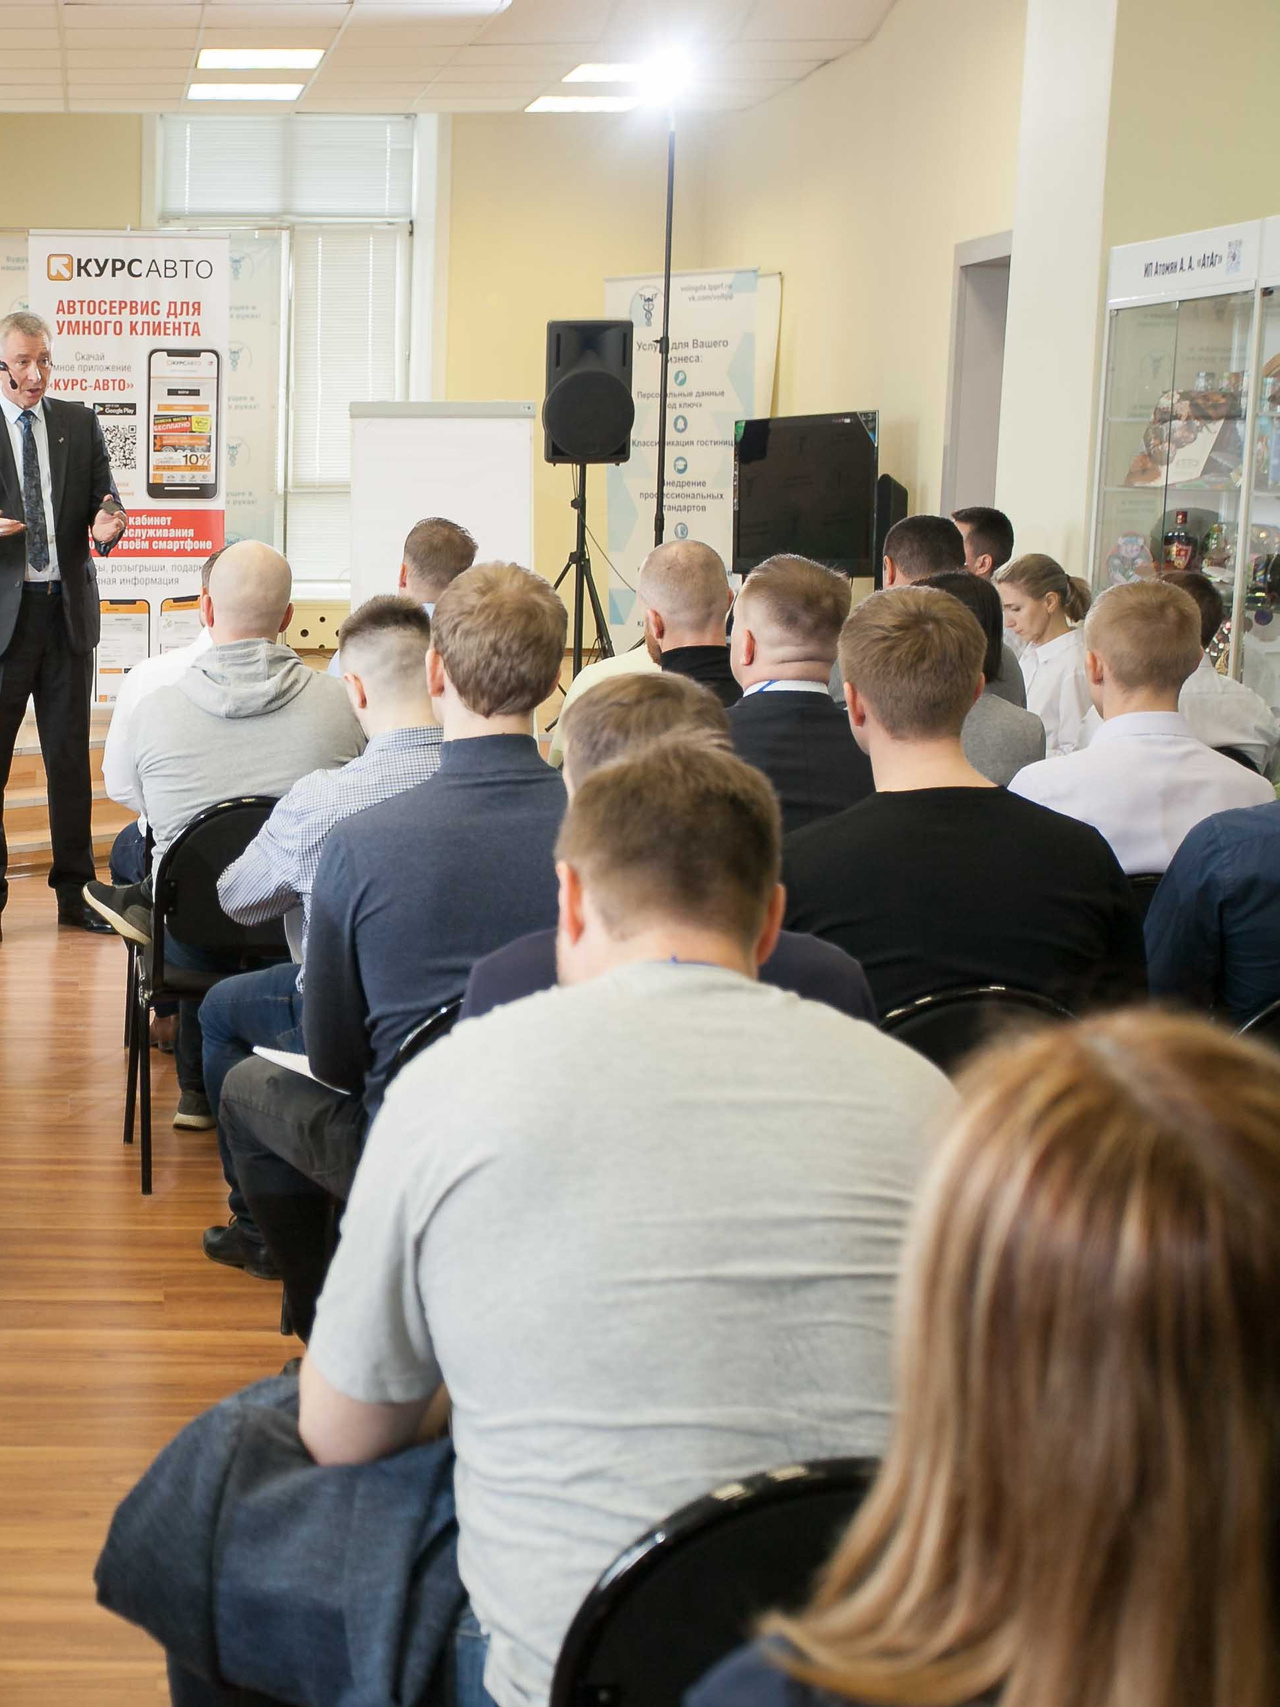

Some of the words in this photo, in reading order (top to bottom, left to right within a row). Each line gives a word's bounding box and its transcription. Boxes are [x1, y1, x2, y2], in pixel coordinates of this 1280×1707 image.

[1143, 262, 1153, 278] ИП
[56, 299, 161, 316] АВТОСЕРВИС
[166, 301, 201, 319] ДЛЯ
[56, 320, 123, 336] УМНОГО
[129, 321, 201, 337] КЛИЕНТА
[671, 341, 689, 350] для
[692, 339, 729, 349] Вашего
[75, 351, 105, 361] Скачай
[53, 364, 75, 372] мное
[77, 364, 132, 374] приложение
[694, 390, 725, 399] данные
[104, 407, 123, 415] Google
[123, 407, 135, 415] Play
[696, 439, 734, 447] гостиниц
[182, 453, 211, 466] 10%
[665, 480, 707, 489] недрение
[663, 504, 707, 513] тандартов
[128, 515, 172, 526] кабинет
[118, 539, 149, 550] твоём
[152, 538, 213, 552] смартфоне
[111, 565, 166, 574] розыгрыши,
[120, 577, 180, 587] информация
